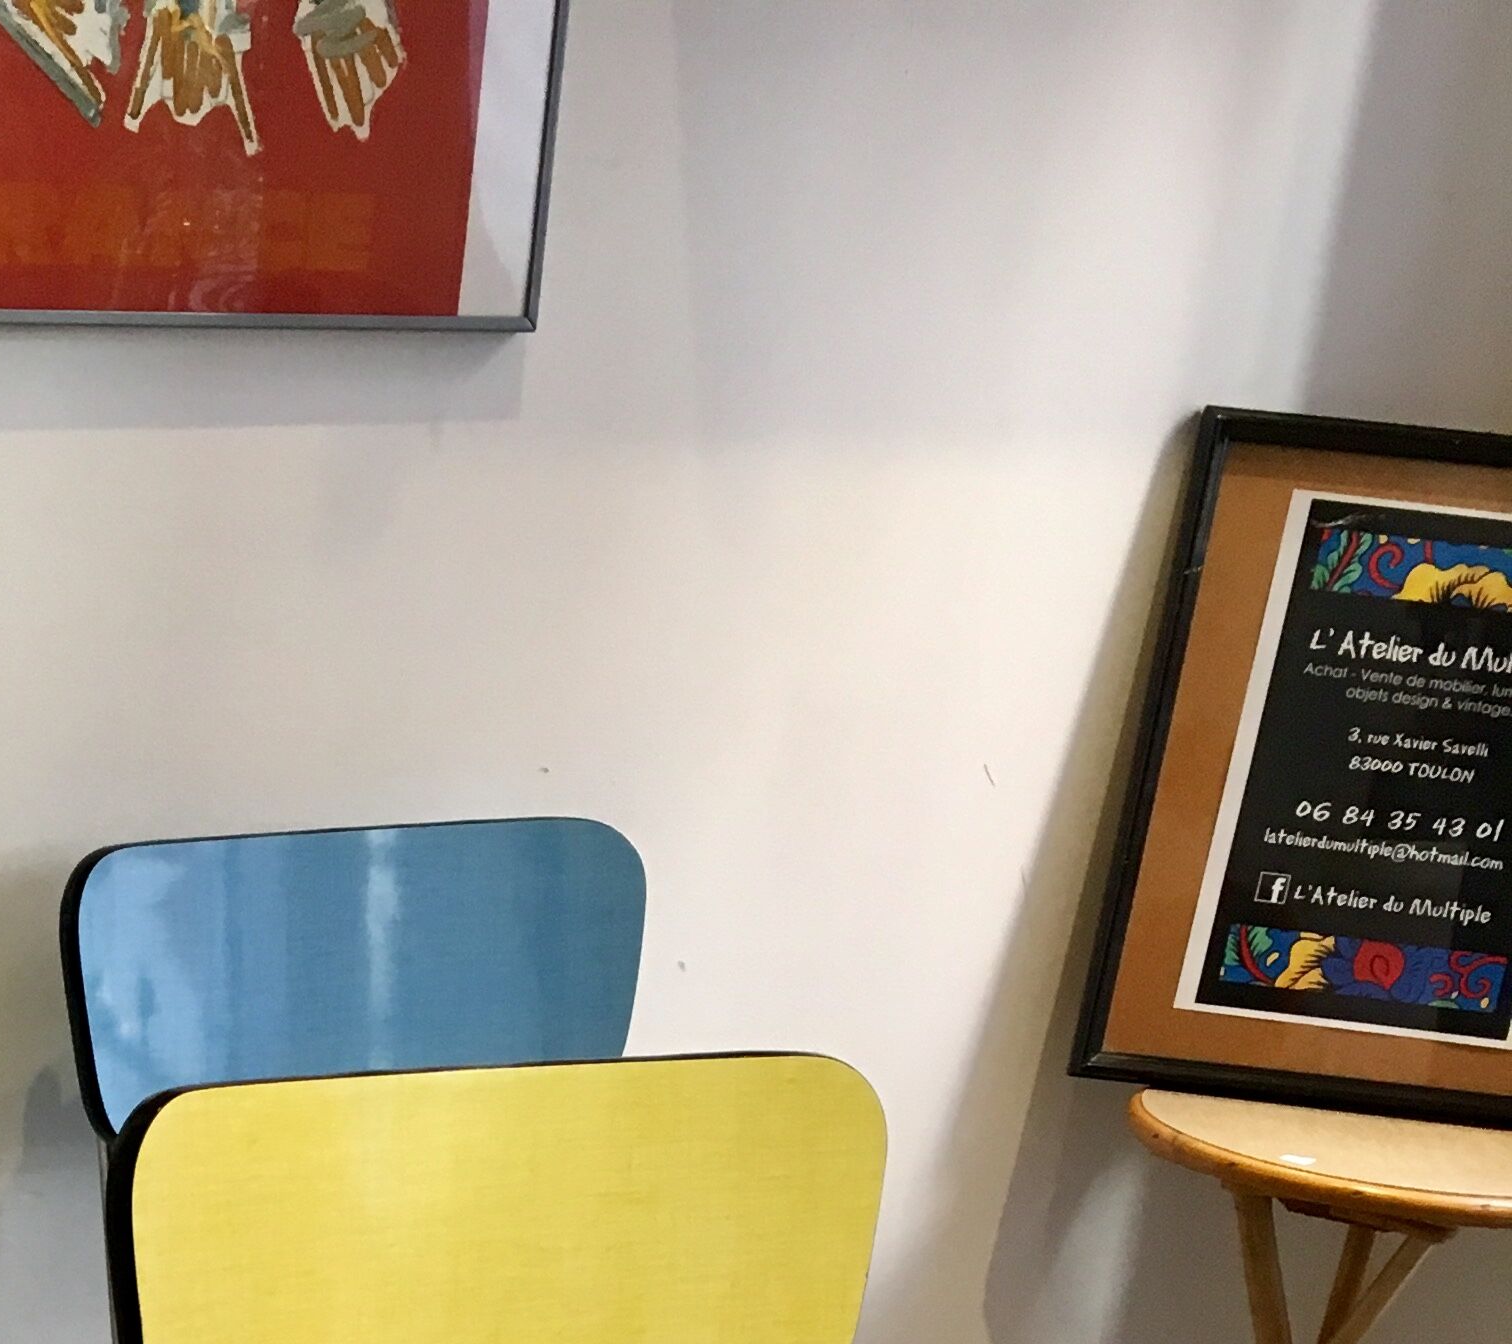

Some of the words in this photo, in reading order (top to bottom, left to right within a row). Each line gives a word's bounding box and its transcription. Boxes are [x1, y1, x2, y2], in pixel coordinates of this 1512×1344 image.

[1428, 642, 1457, 667] du
[1303, 662, 1348, 679] Achat
[1360, 668, 1403, 686] Vente
[1406, 674, 1425, 689] de
[1345, 686, 1389, 703] objets
[1392, 691, 1439, 710] design
[1441, 696, 1453, 710] &
[1366, 733, 1390, 746] rue
[1393, 732, 1438, 752] Xavier
[1441, 738, 1489, 758] Savelli
[1348, 755, 1404, 774] 83000
[1408, 762, 1476, 784] TOULON
[1295, 800, 1332, 822] 06
[1342, 805, 1375, 827] 84
[1388, 810, 1421, 831] 35
[1432, 817, 1466, 838] 43
[1475, 819, 1505, 842] 01
[1263, 827, 1504, 871] latelierdumultiple@hotmail.com
[1293, 884, 1378, 909] L'Atelier
[1382, 894, 1404, 913] du
[1408, 898, 1492, 926] Multiple
